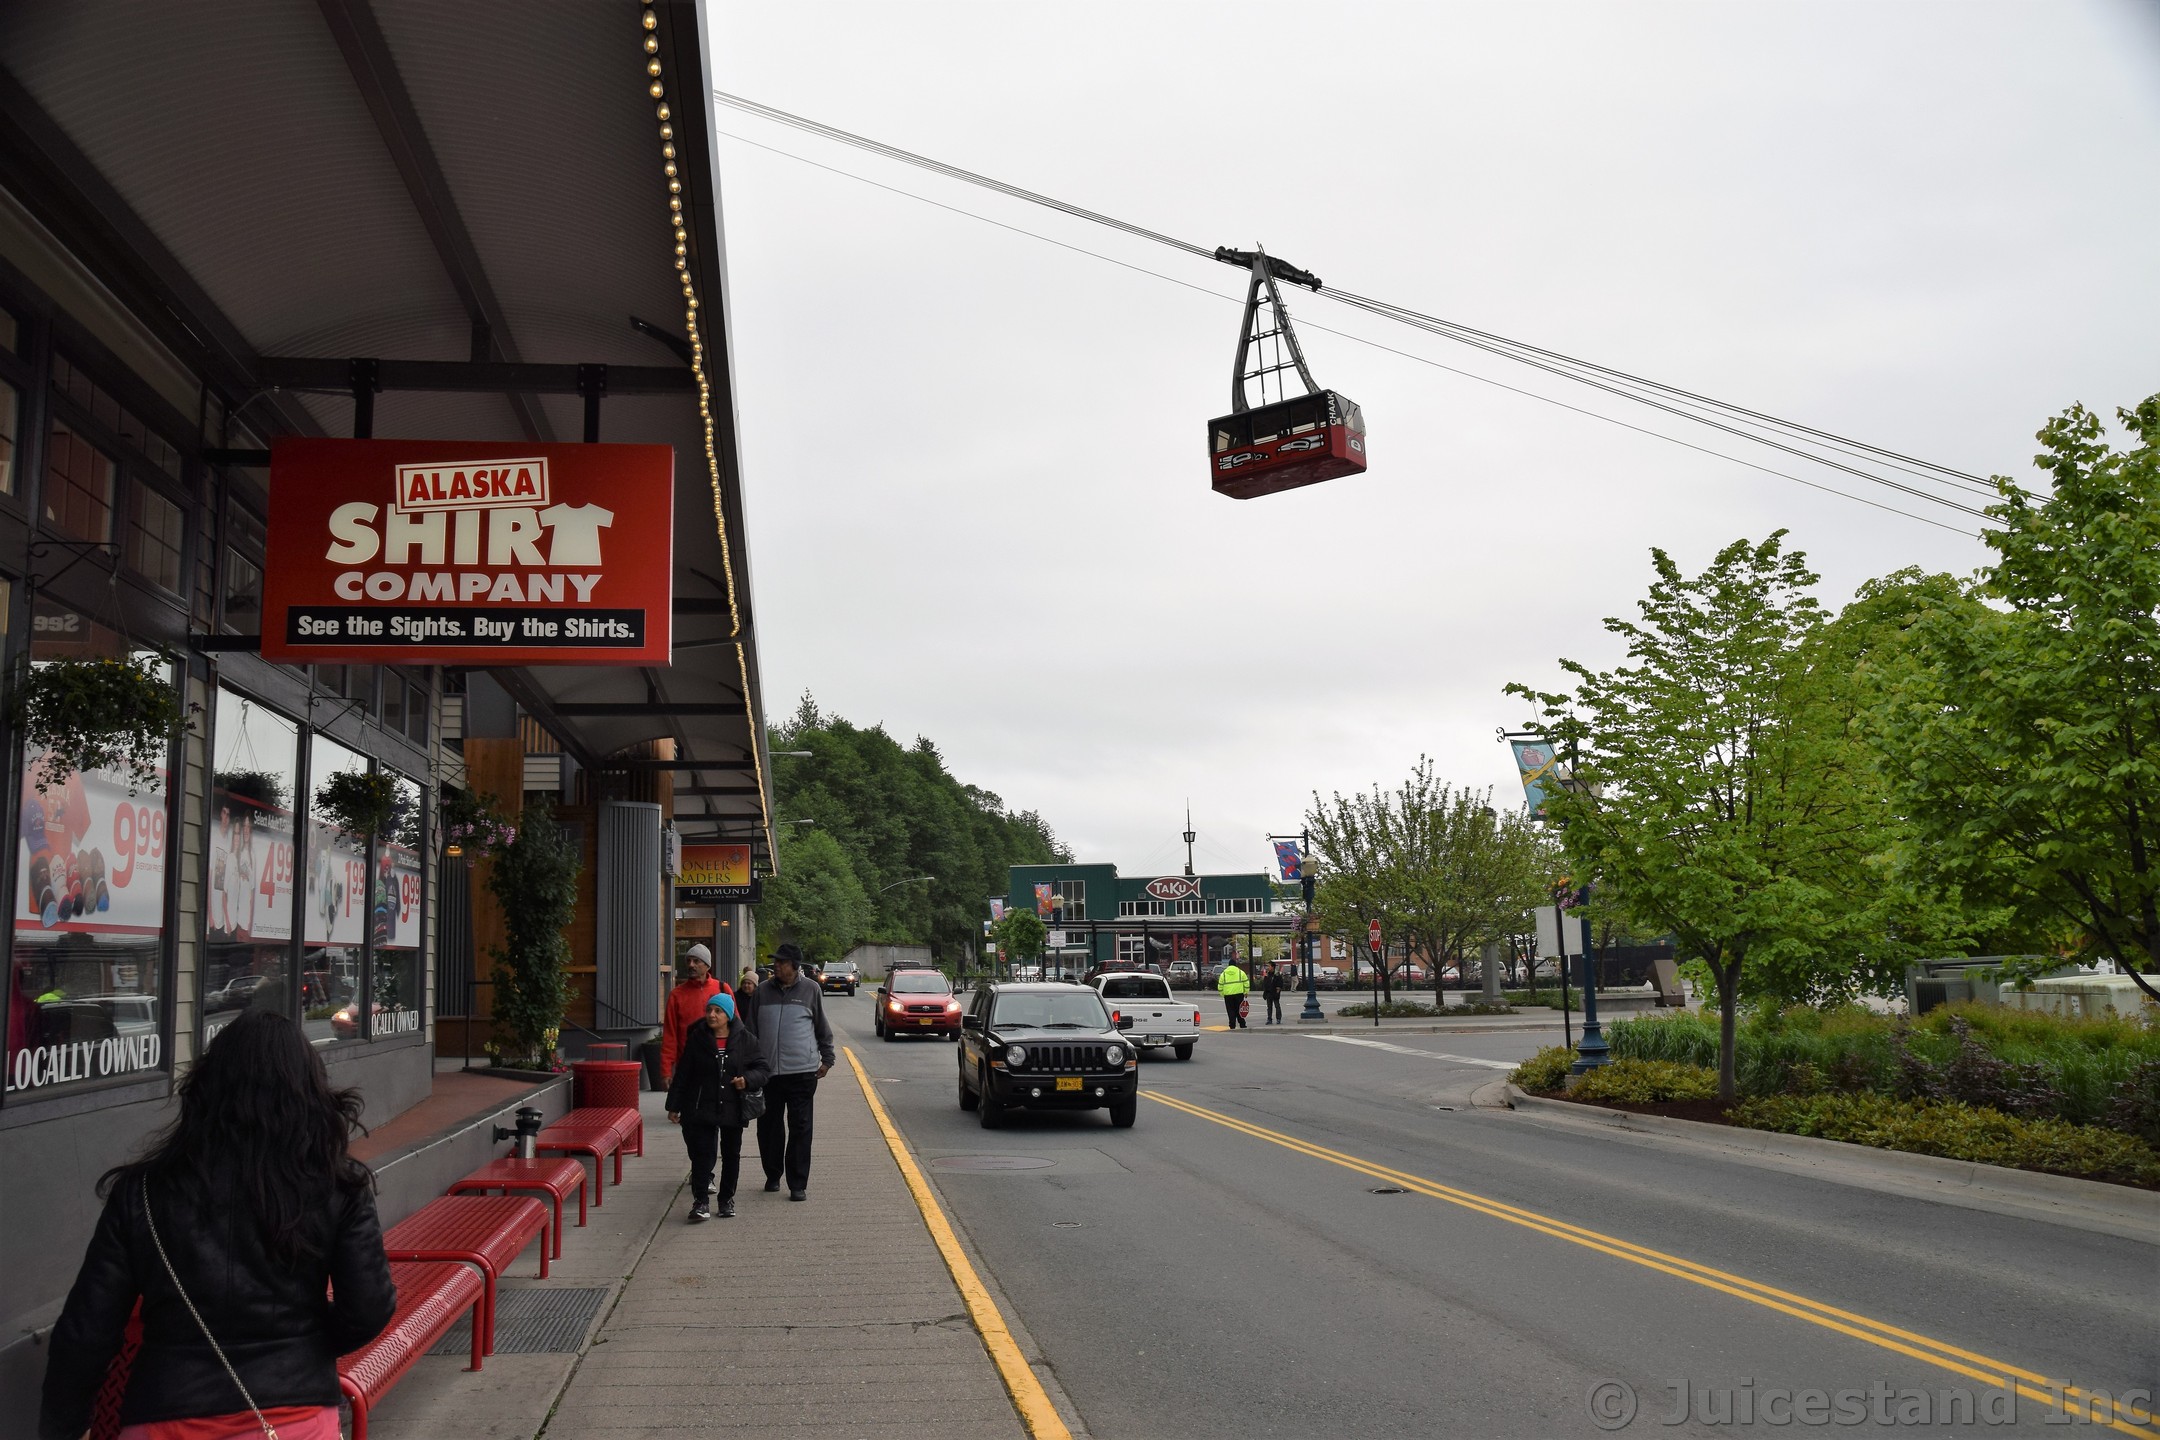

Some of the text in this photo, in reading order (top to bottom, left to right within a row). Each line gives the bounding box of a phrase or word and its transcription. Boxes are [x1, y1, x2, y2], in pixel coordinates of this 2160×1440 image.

[408, 467, 537, 502] ALASKA
[325, 502, 615, 566] SHIRT
[333, 571, 603, 603] COMPANY
[298, 615, 635, 642] See the Sights. Buy the Shirts.
[677, 873, 730, 883] RADERS
[682, 860, 731, 871] ONEER
[1154, 881, 1187, 896] TAKU
[1370, 929, 1381, 942] STOP
[371, 1010, 419, 1036] OCALLY OWNED
[6, 1040, 95, 1092] LOCALLY
[99, 1034, 161, 1076] OWNED
